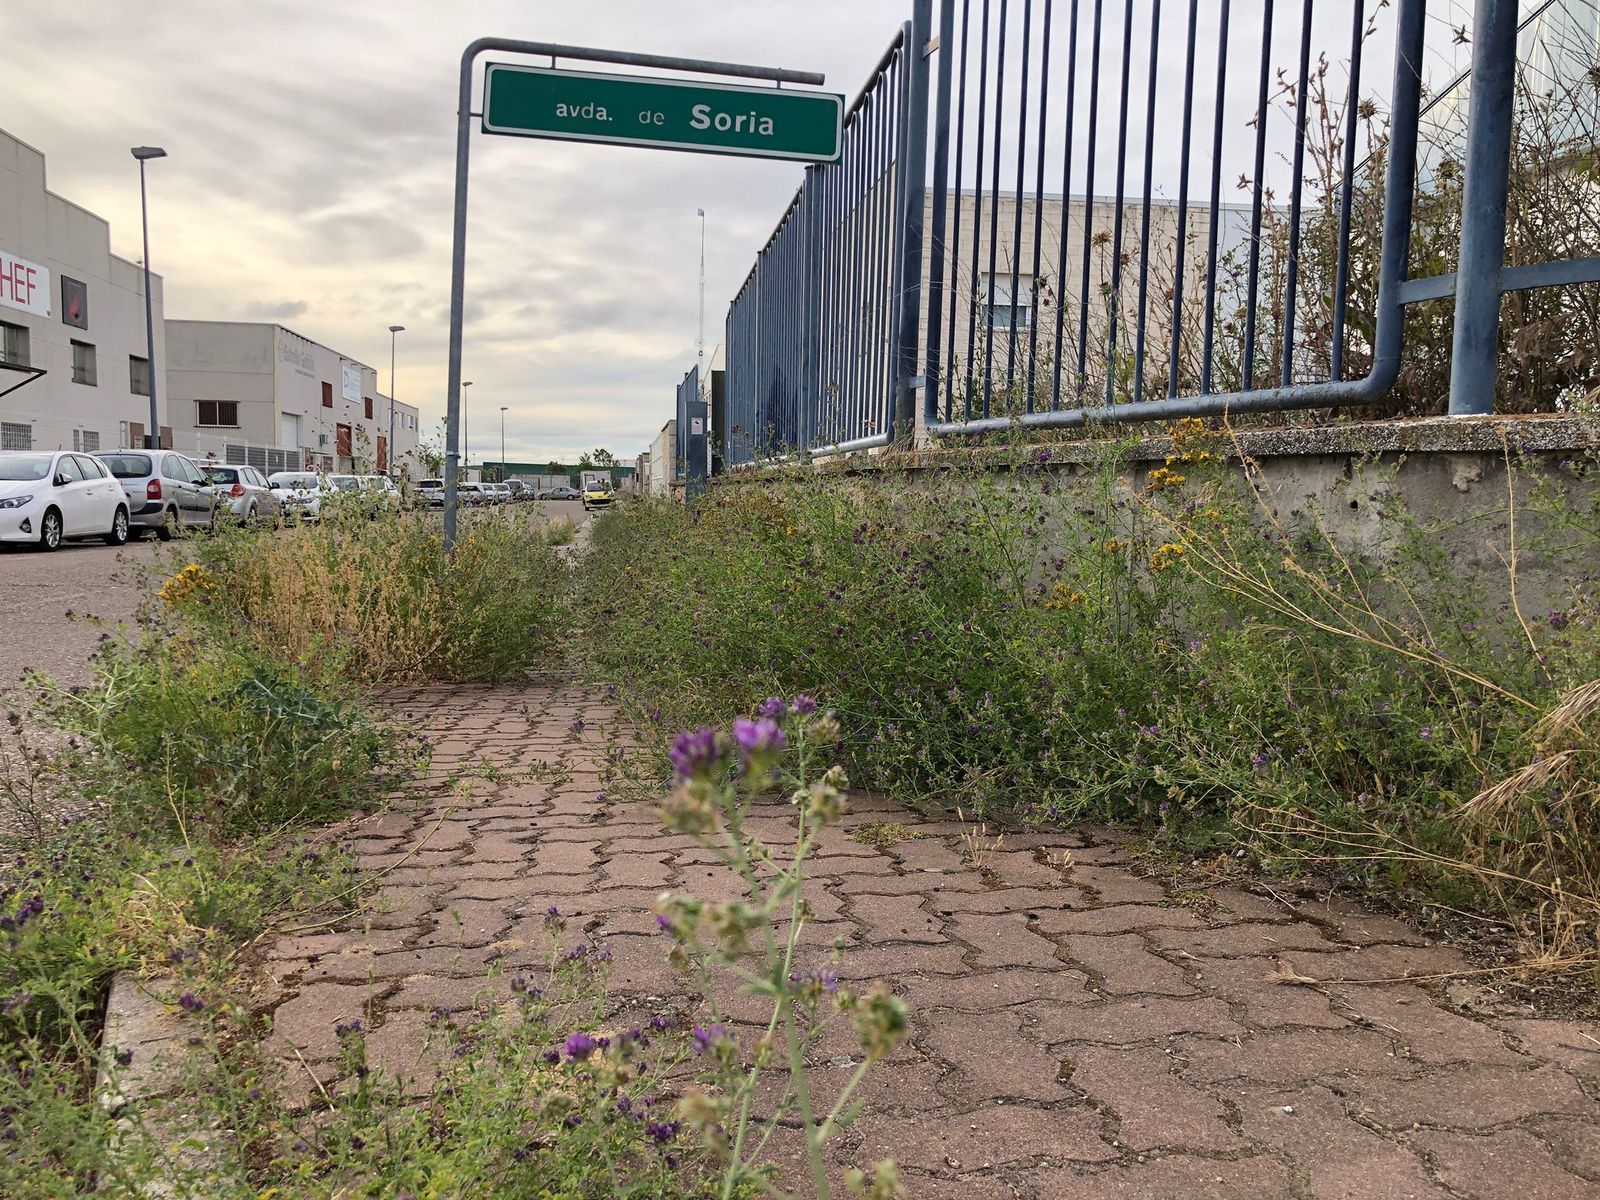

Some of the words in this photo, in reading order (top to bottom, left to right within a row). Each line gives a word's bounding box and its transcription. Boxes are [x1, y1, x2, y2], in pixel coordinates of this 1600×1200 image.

[556, 102, 613, 121] avda.
[638, 110, 665, 126] de
[689, 104, 774, 136] Soria
[0, 257, 37, 305] HEF
